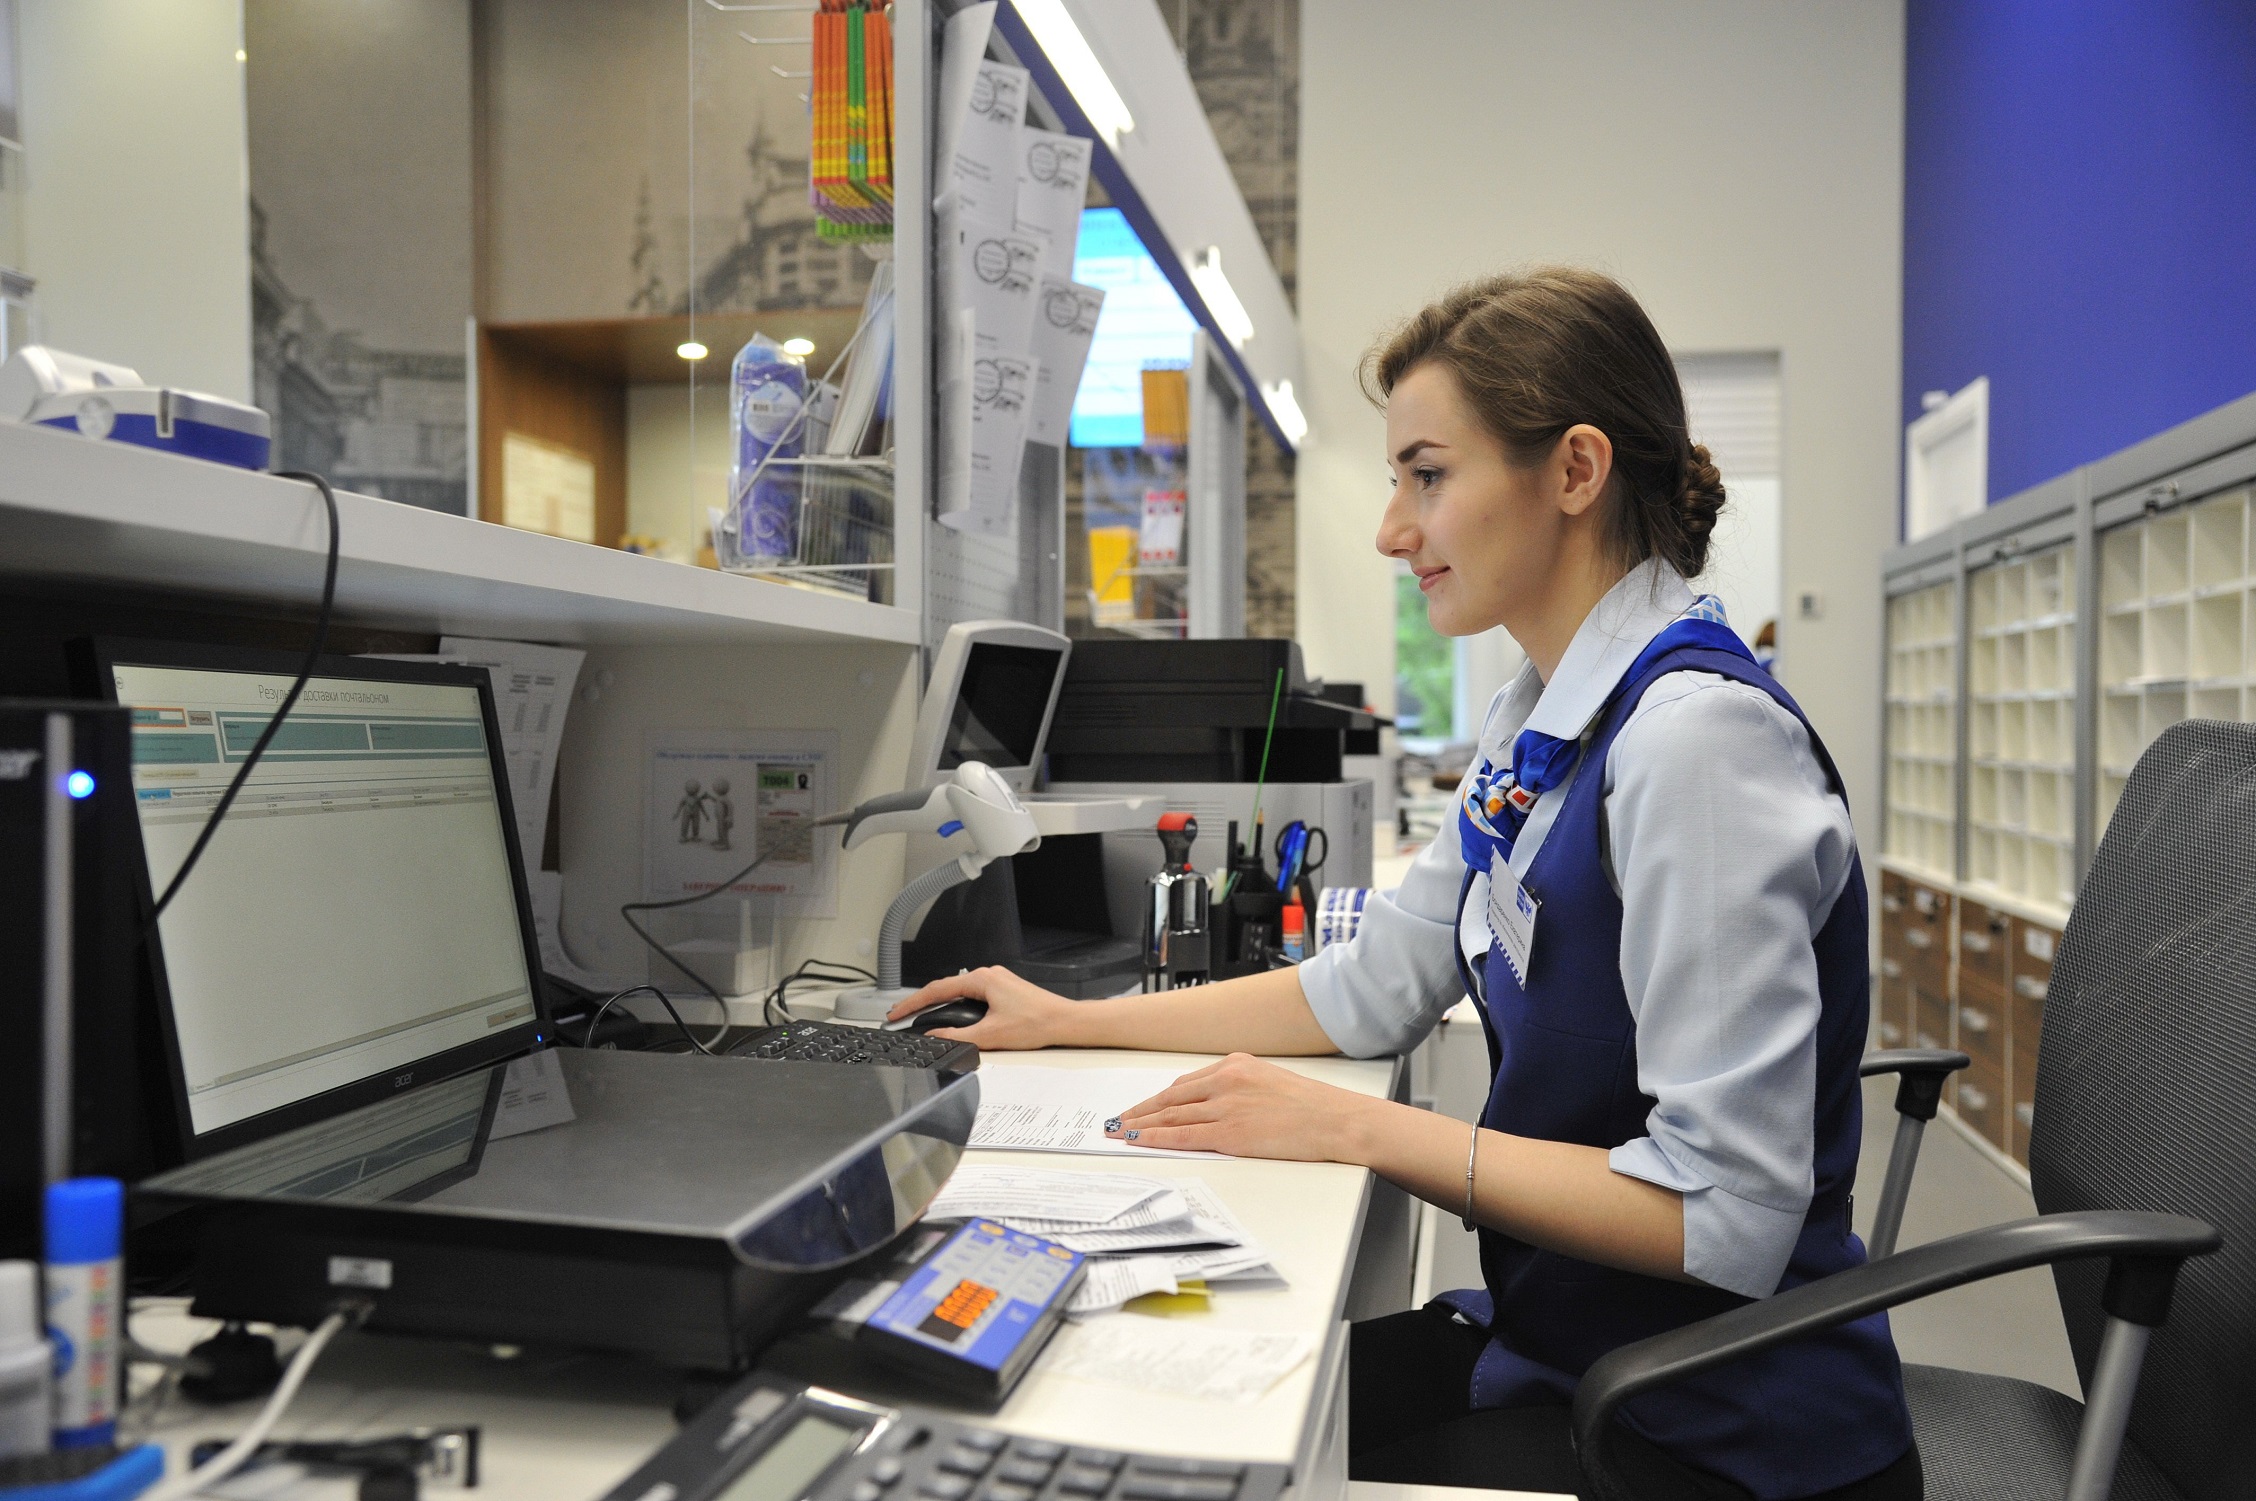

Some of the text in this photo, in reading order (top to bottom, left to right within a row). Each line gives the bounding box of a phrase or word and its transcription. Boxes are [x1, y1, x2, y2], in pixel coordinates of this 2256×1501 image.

[303, 691, 338, 702] доставки
[340, 692, 389, 704] почтальоном
[395, 1072, 414, 1088] acer
